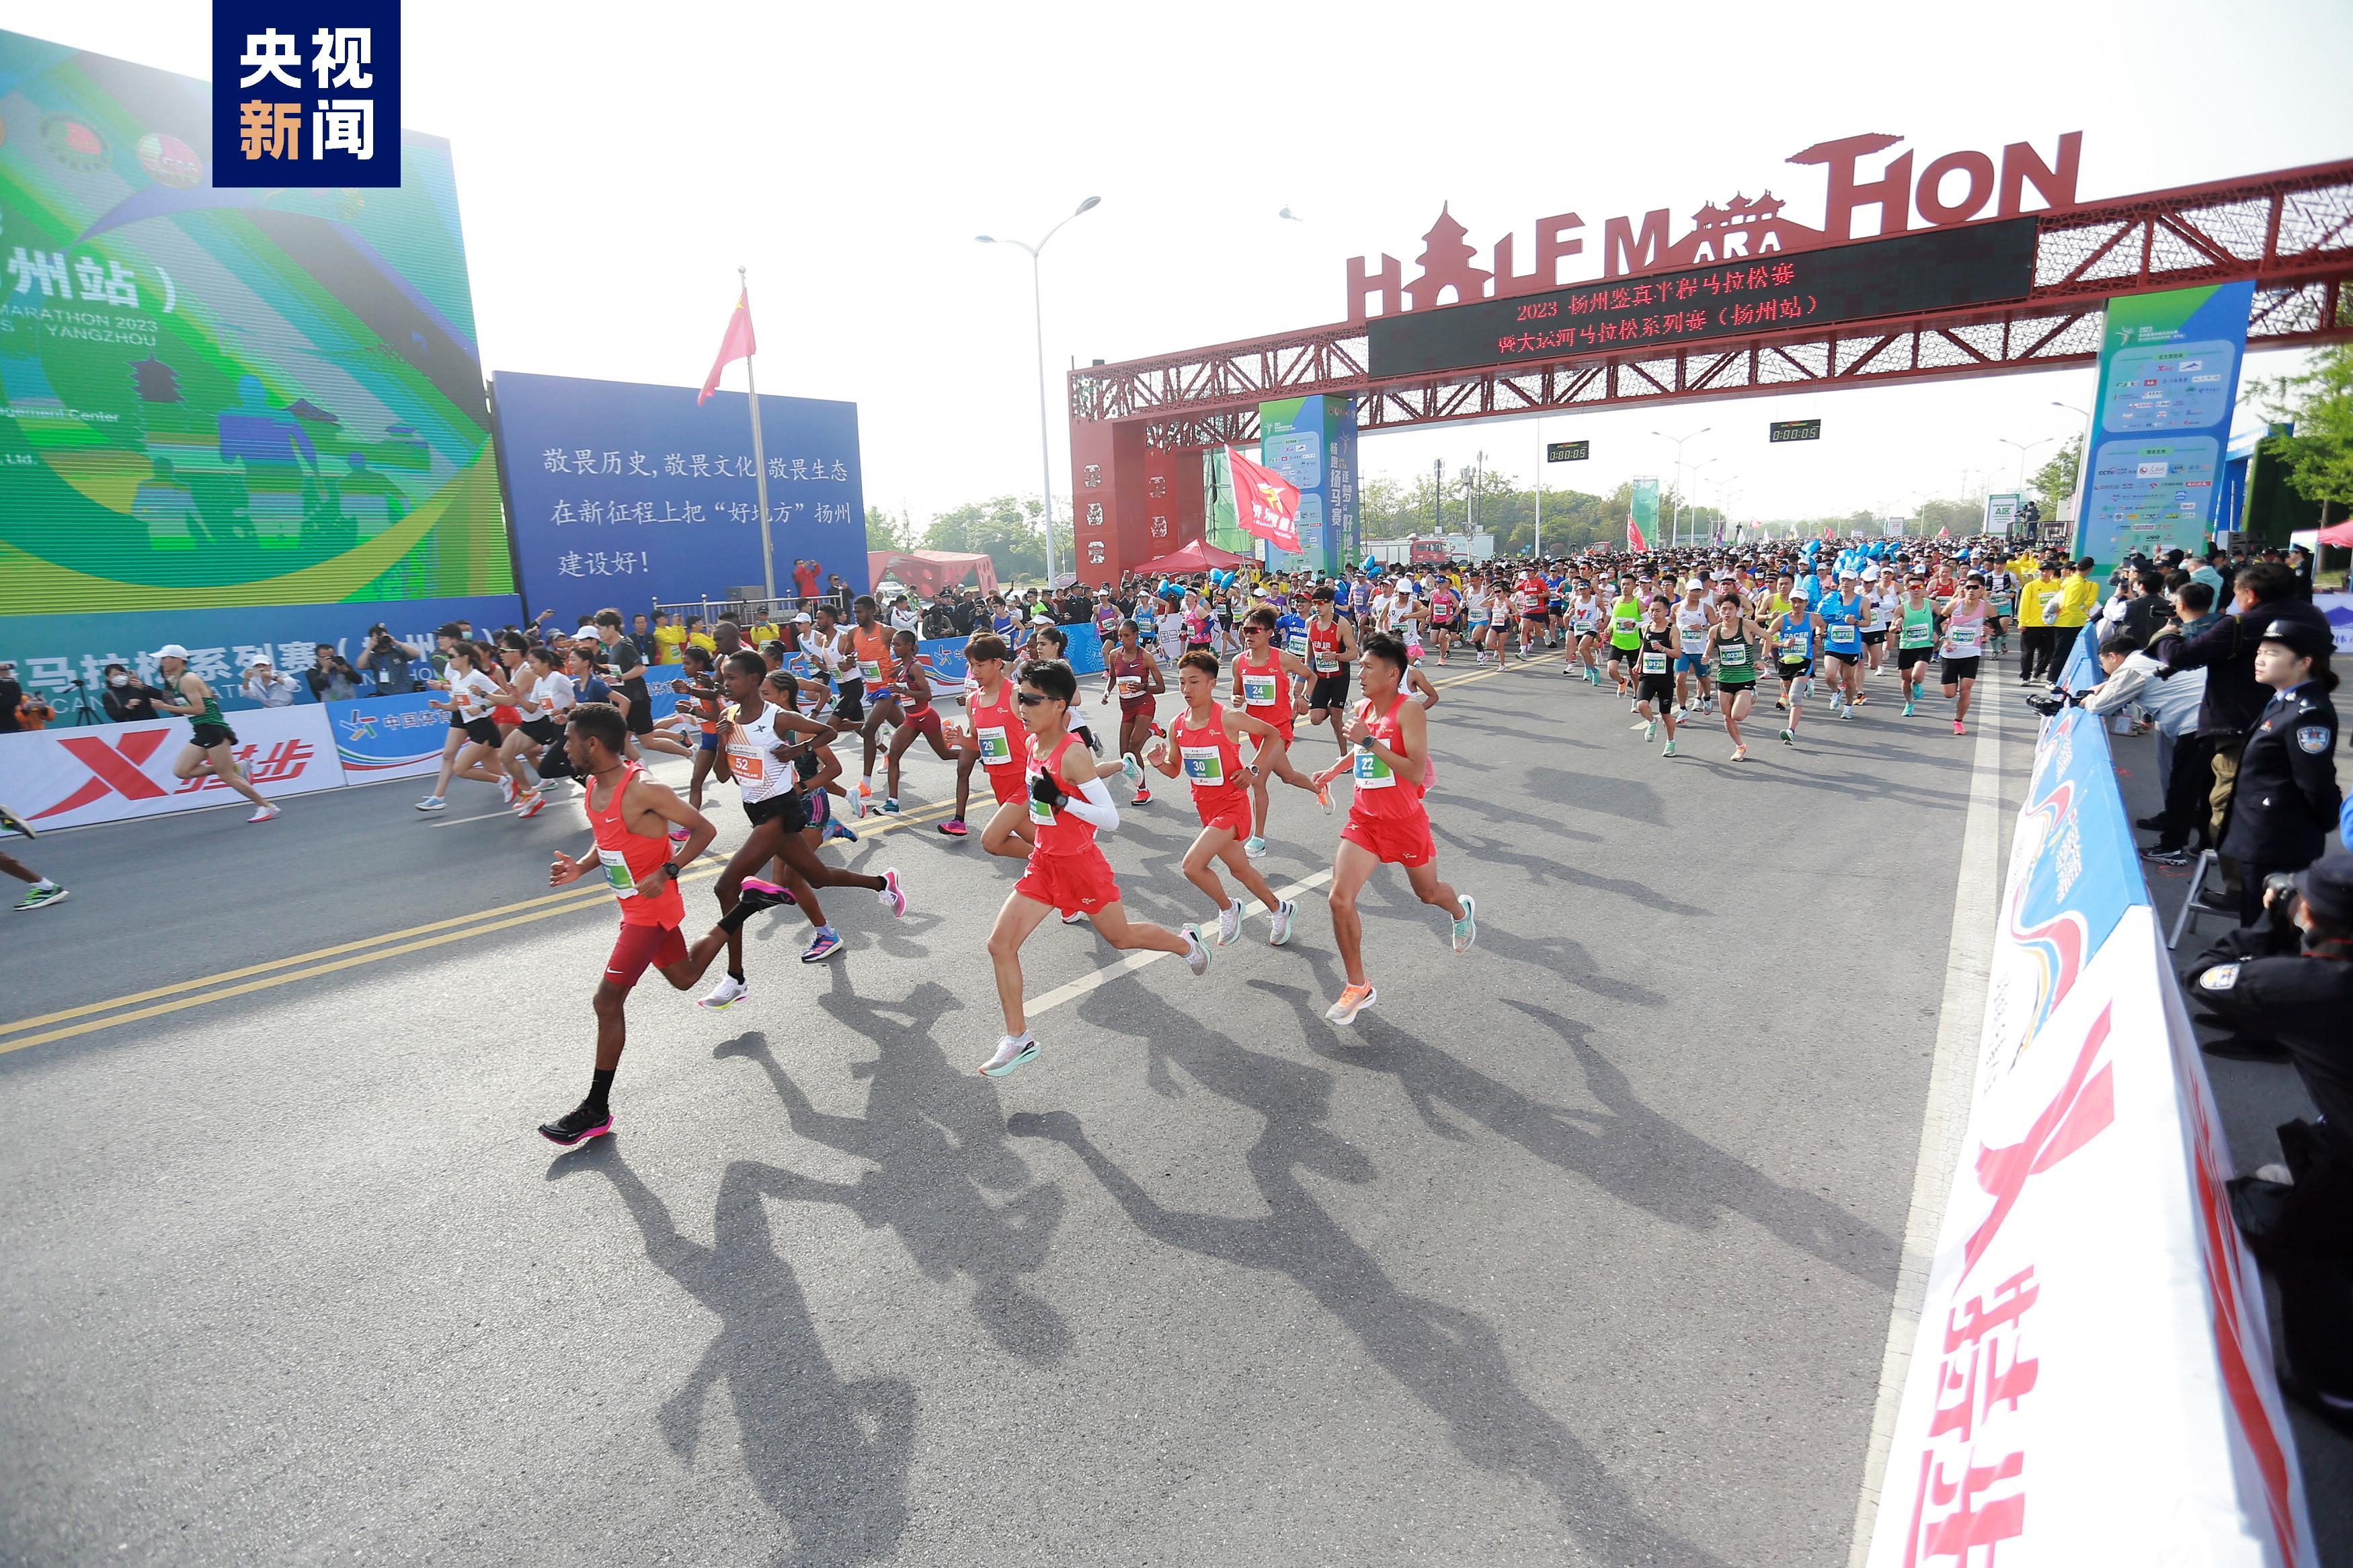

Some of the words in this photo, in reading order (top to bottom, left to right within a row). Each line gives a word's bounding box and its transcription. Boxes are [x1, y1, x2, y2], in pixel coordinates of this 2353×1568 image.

[1517, 301, 1558, 321] 2023
[115, 316, 159, 333] 2023
[44, 324, 157, 347] YANGZHOU
[69, 409, 120, 422] Center
[1772, 427, 1817, 441] 0:00:05
[1550, 449, 1585, 460] 0:00:05
[543, 448, 848, 483] 敬畏历史,敬畏文化敬畏生态
[557, 550, 649, 579] 建设好!
[1252, 686, 1264, 694] 24
[983, 741, 994, 751] 29
[735, 757, 748, 771] 52
[1193, 761, 1205, 772] 30
[1361, 757, 1373, 770] 22
